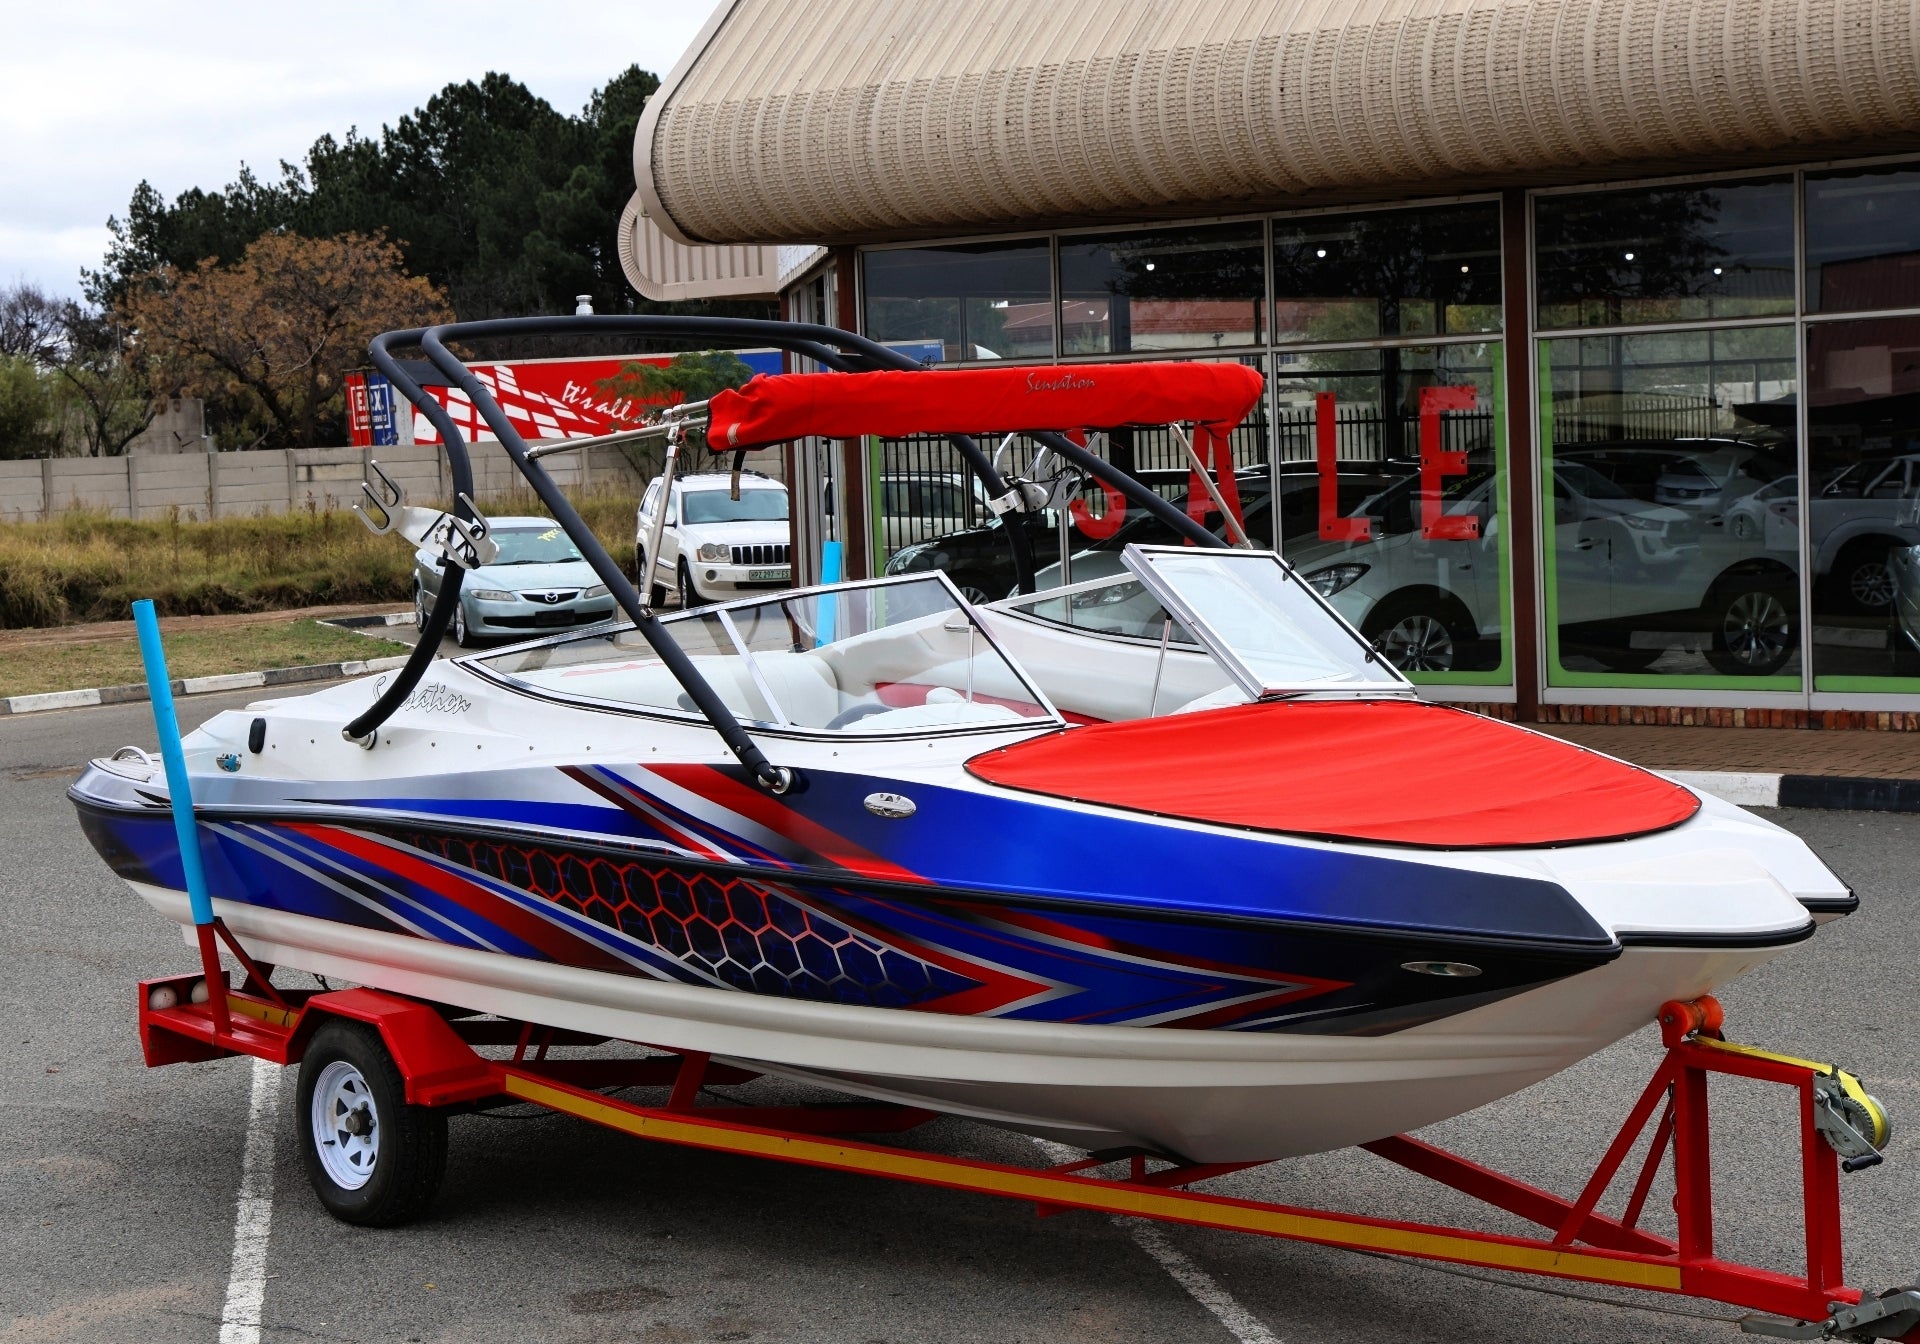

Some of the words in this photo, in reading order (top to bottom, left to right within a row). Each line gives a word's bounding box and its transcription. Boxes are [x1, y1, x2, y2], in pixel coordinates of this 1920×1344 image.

[1025, 371, 1096, 394] Sensation
[561, 380, 594, 410] It's
[594, 396, 632, 421] all
